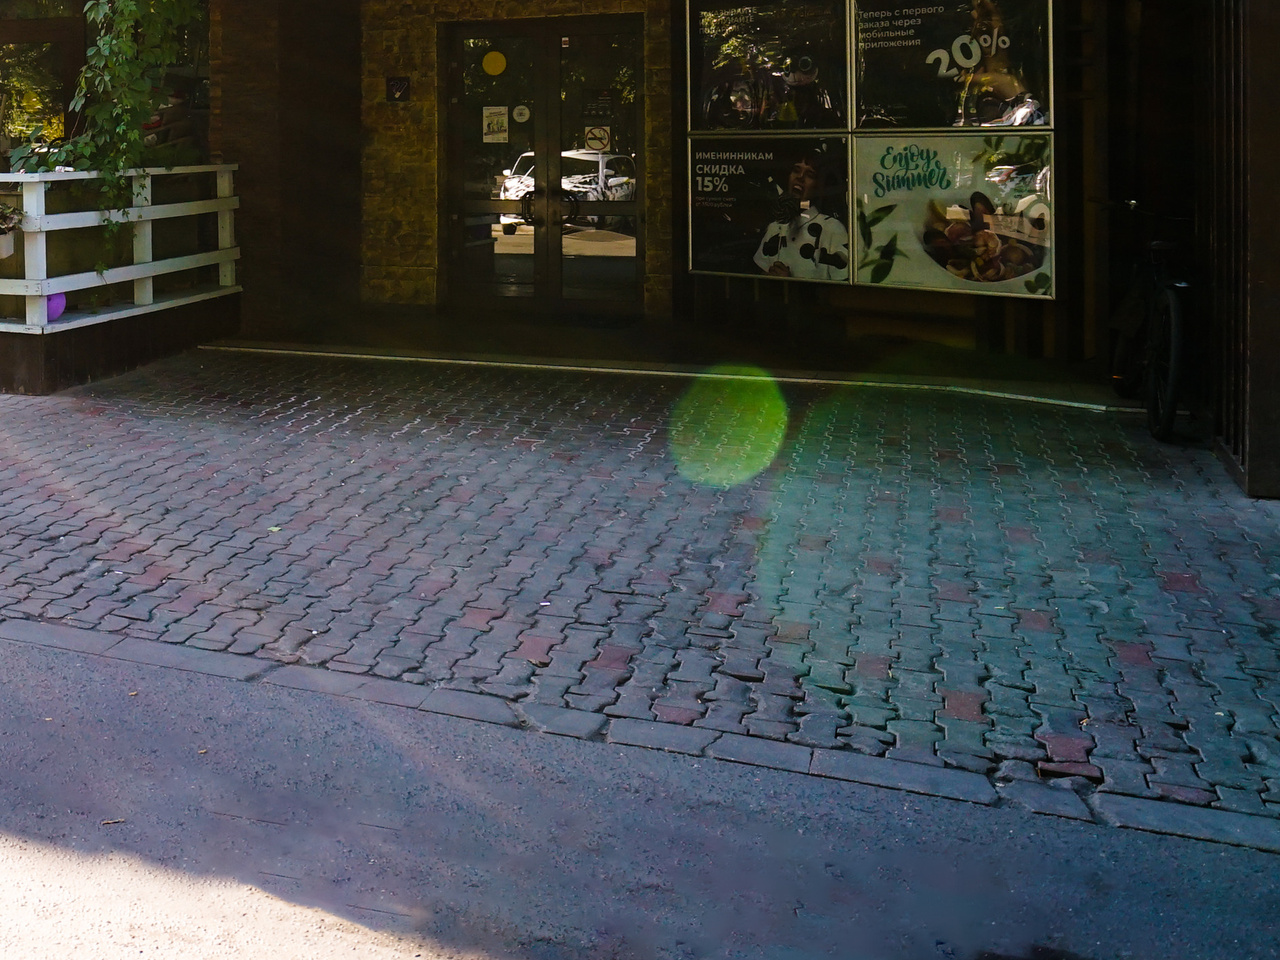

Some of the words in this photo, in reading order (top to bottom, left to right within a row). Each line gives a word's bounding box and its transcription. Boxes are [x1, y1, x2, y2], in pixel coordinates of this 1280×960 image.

[858, 9, 892, 20] Теперь
[894, 9, 901, 17] с
[902, 5, 945, 17] первого
[858, 20, 890, 30] заказа
[892, 17, 922, 29] через
[858, 28, 915, 39] мобильные
[858, 38, 921, 51] приложения
[925, 26, 1011, 79] 20%
[695, 151, 774, 161] ИМЕНИННИКАМ
[880, 143, 938, 172] Enjoy
[695, 164, 746, 177] СКИДКА
[695, 176, 729, 193] 15%
[872, 159, 952, 198] Summer
